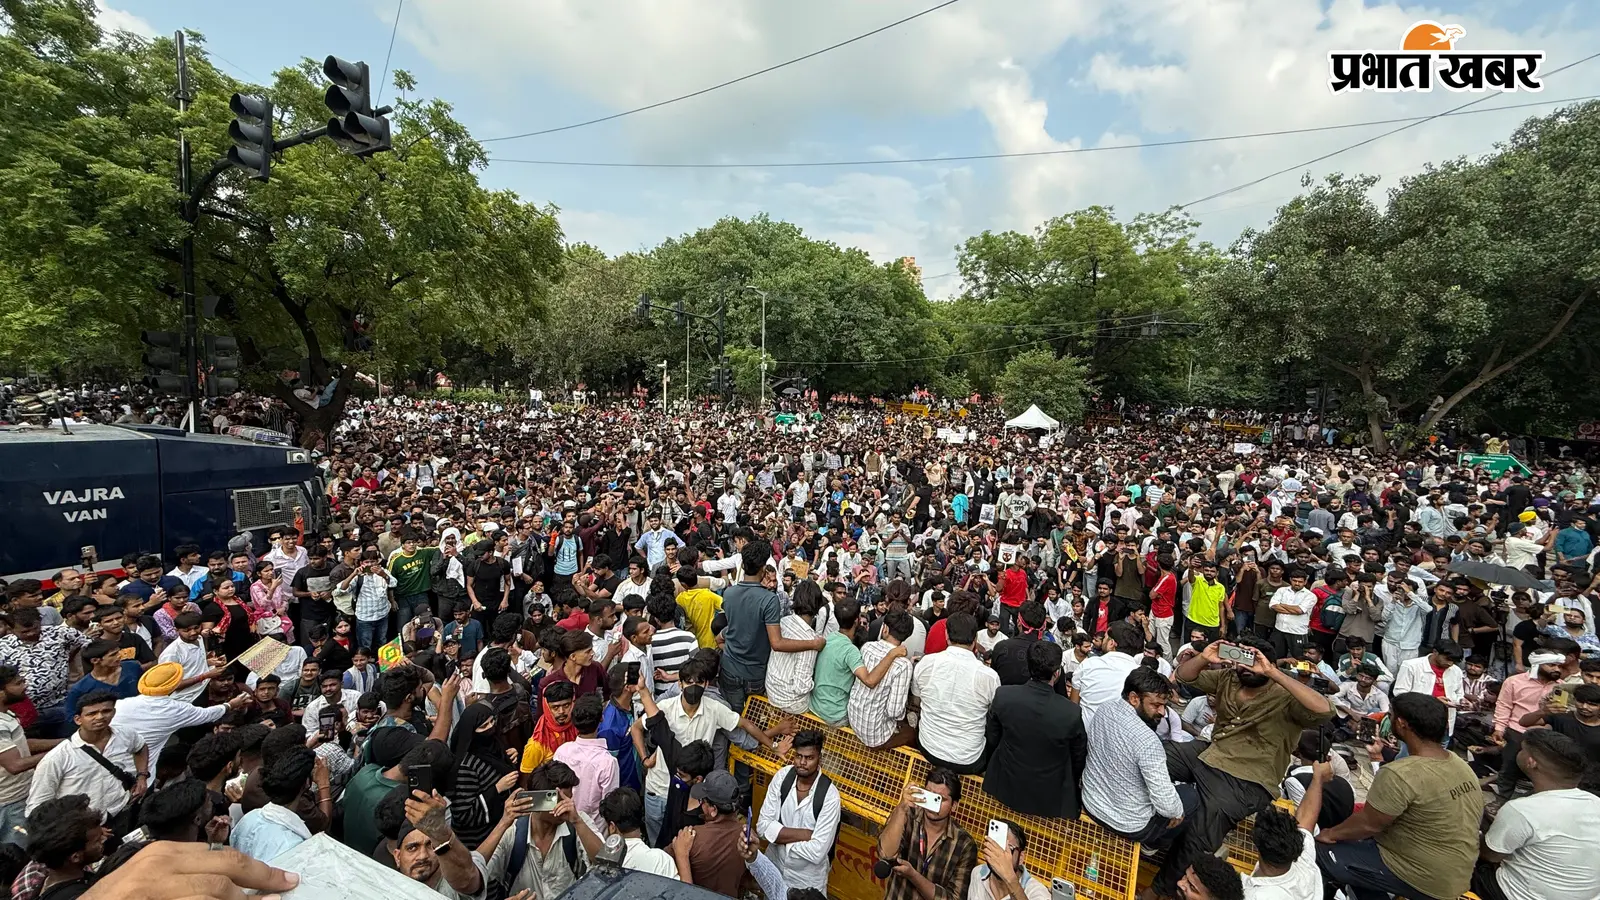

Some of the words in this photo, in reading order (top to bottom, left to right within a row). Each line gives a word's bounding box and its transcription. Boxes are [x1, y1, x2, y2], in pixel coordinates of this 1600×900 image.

[43, 486, 125, 505] VAJRA
[63, 508, 107, 523] VAN
[1449, 780, 1477, 801] PRADA
